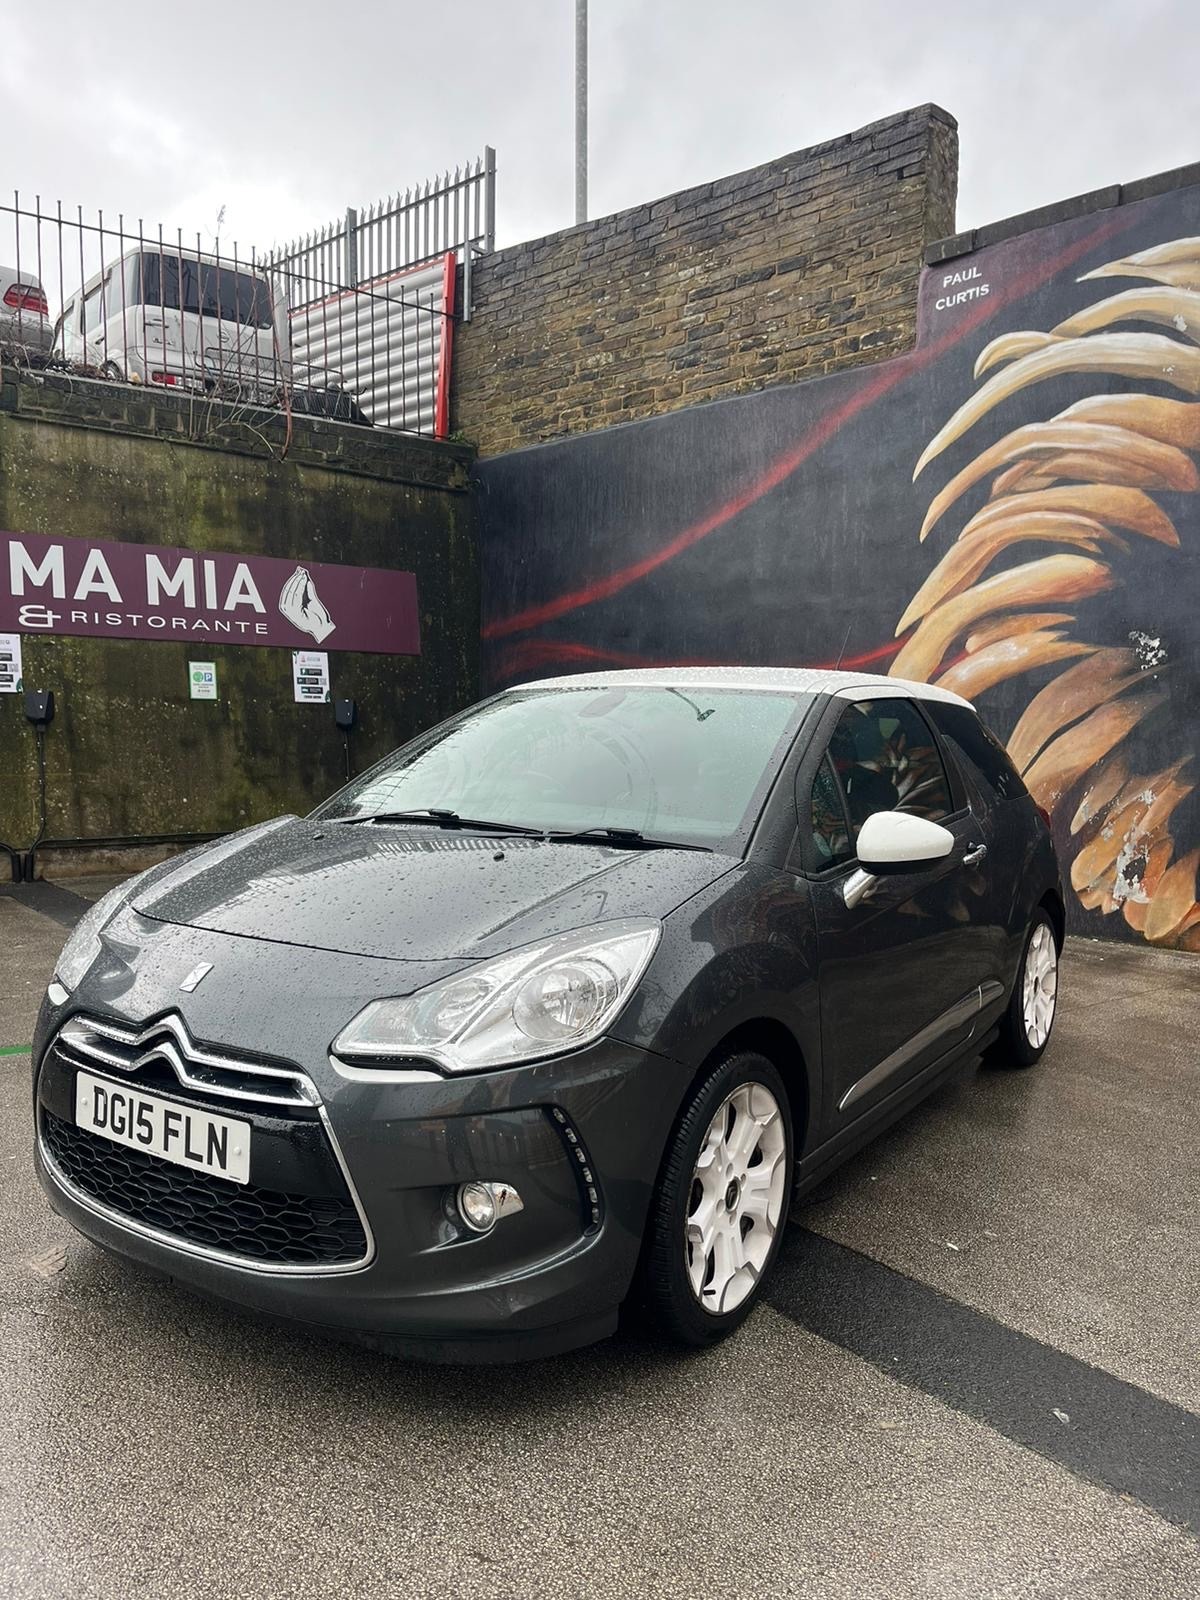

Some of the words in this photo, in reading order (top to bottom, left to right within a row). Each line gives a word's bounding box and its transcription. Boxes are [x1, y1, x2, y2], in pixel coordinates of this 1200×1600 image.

[943, 267, 982, 288] PAUL
[935, 284, 990, 310] CURTIS
[9, 540, 123, 603] MA
[146, 554, 267, 613] MIA
[18, 605, 61, 628] &
[71, 611, 268, 635] RISTORANTE
[93, 1085, 154, 1145] DG15
[163, 1109, 228, 1170] FLN
